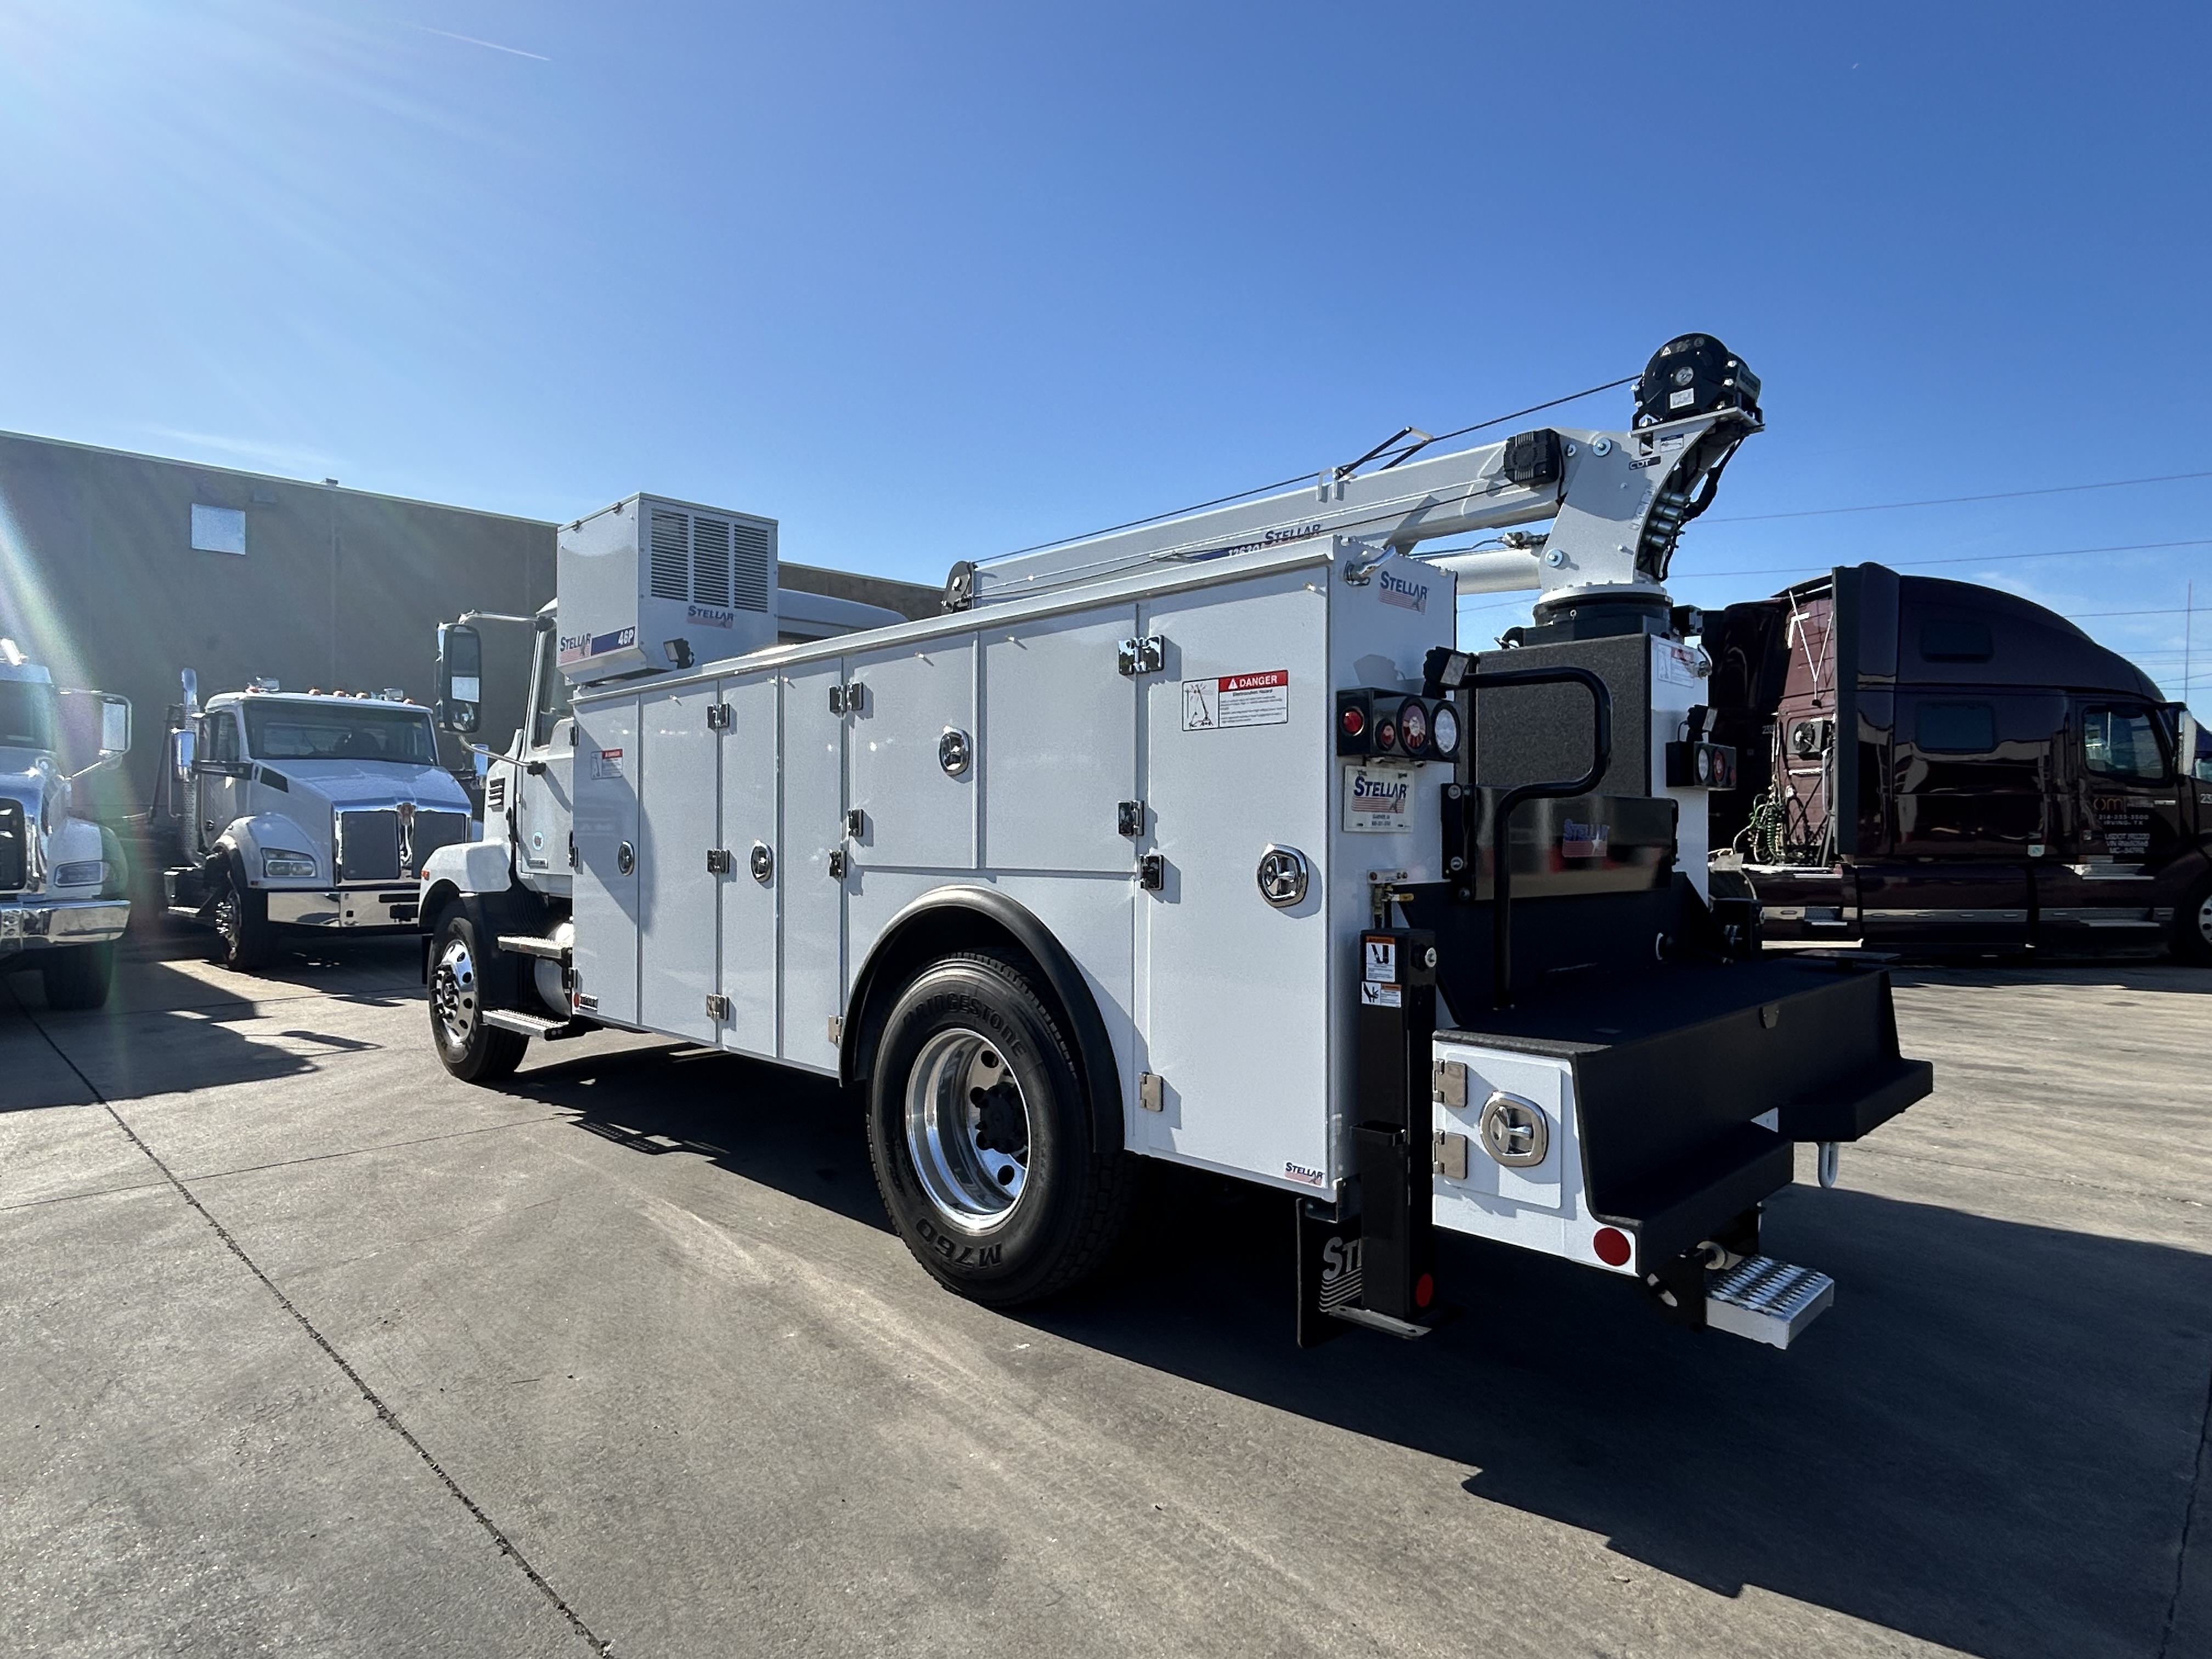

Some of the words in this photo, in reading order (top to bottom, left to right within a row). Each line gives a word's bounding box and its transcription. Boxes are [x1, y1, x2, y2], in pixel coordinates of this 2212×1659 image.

[1265, 524, 1321, 542] STELLAR
[1380, 571, 1427, 600] STELLAR
[689, 606, 734, 621] STELLAR
[561, 633, 591, 652] STELLAR
[1239, 675, 1277, 687] DANGER
[1354, 776, 1407, 799] STELLAR
[1564, 819, 1608, 841] STELLAR
[904, 991, 1026, 1057] BRIDGESTONE
[1286, 1162, 1323, 1179] STELLAR
[916, 1218, 1002, 1268] M760
